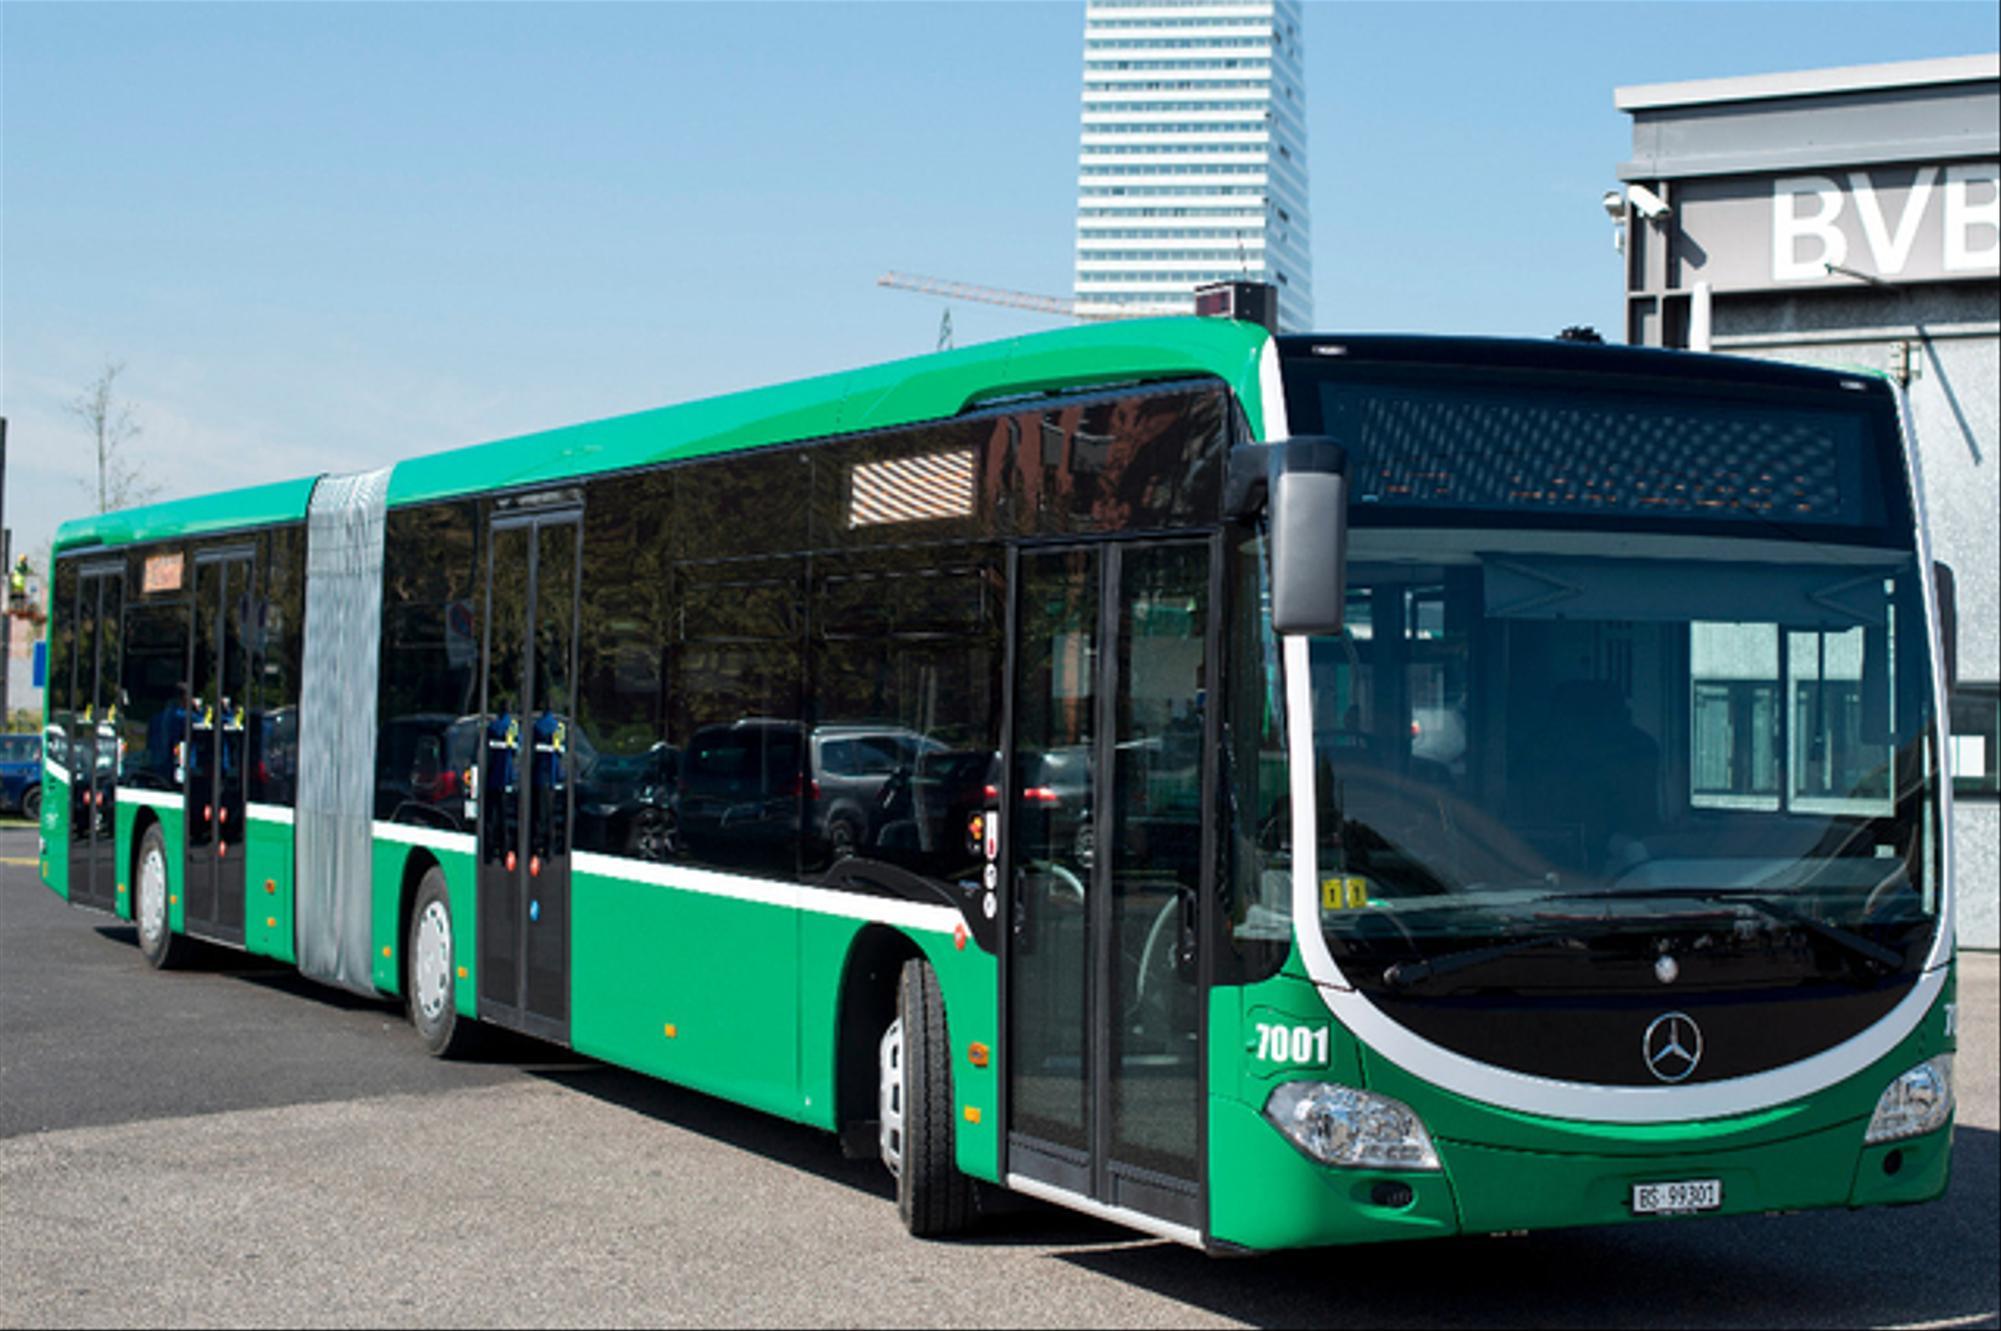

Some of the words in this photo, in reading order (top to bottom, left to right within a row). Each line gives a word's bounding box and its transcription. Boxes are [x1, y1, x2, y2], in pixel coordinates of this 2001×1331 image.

[1772, 164, 1999, 281] BVB
[1256, 1022, 1329, 1063] 7001
[1639, 1186, 1659, 1209] BS
